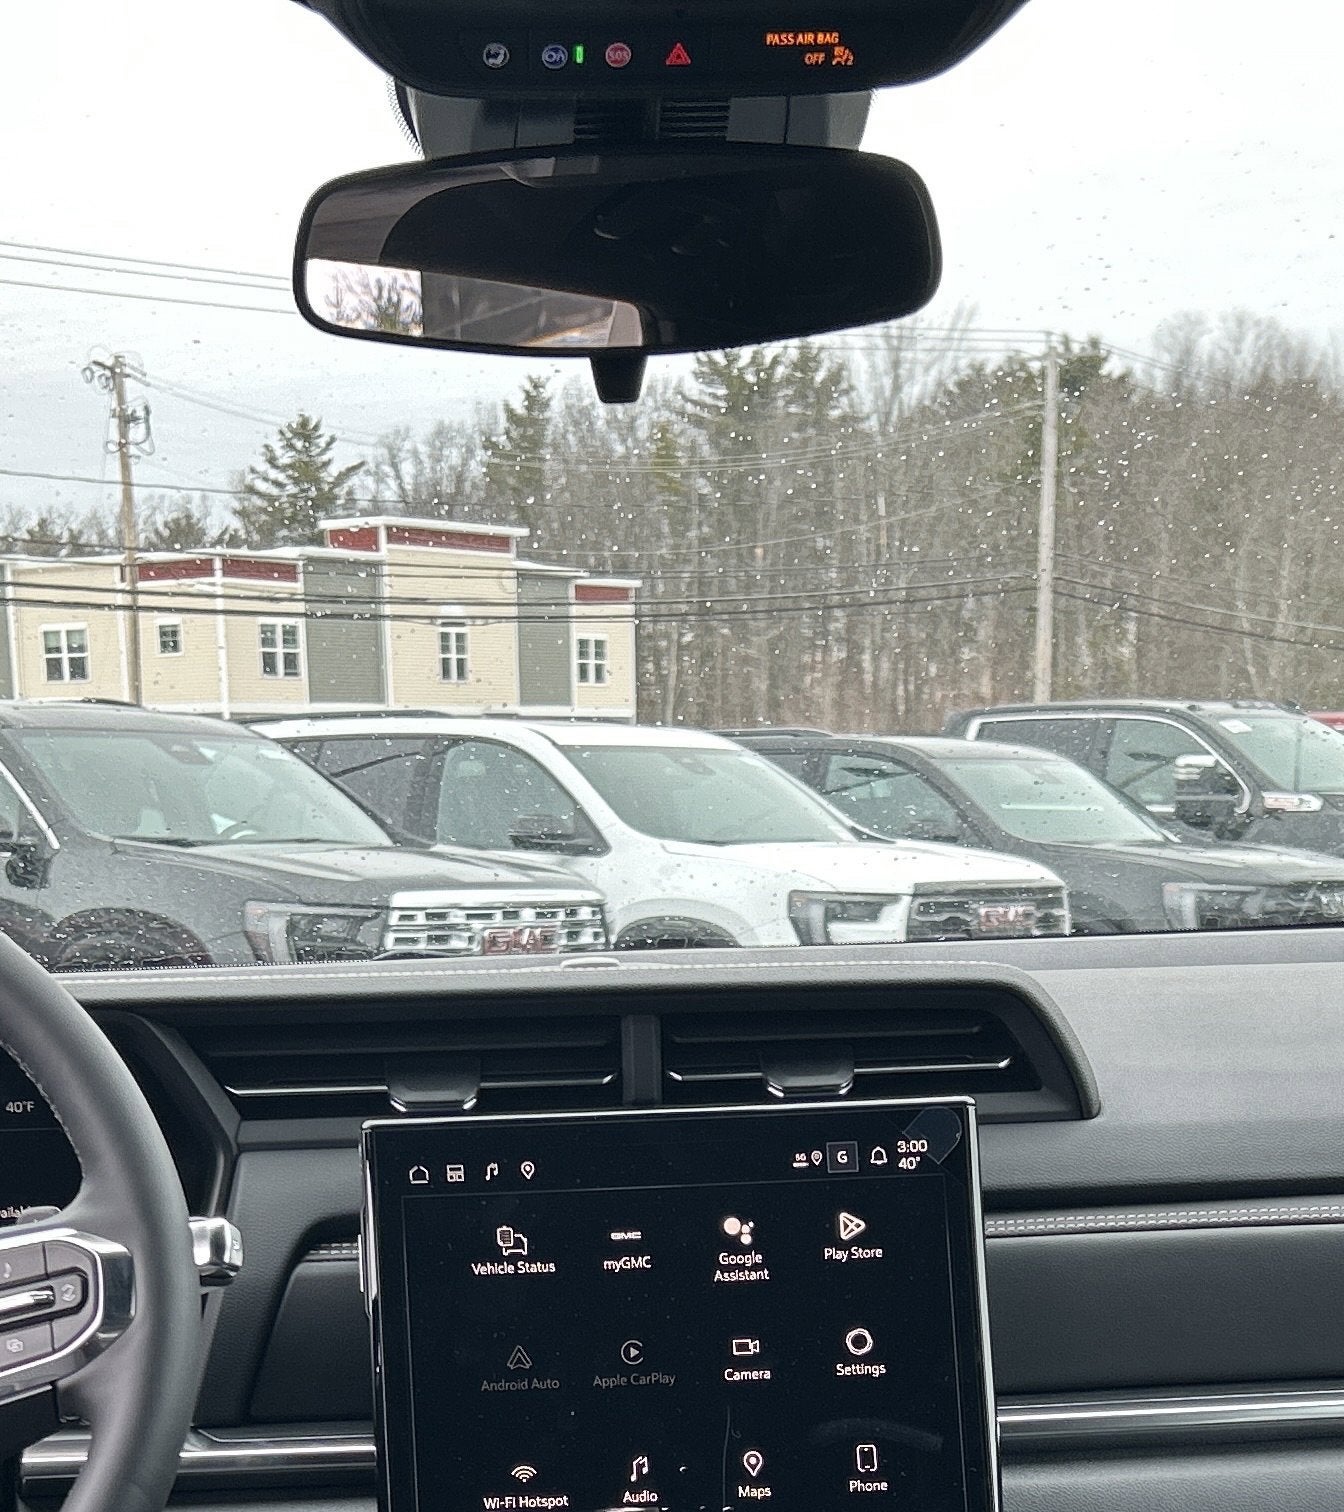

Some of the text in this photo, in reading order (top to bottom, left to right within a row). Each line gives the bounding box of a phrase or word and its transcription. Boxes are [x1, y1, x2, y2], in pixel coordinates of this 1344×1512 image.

[766, 31, 839, 45] PASS AIR BAG
[804, 52, 825, 65] OFF
[6, 1101, 35, 1113] 40°F
[896, 1140, 928, 1153] 3:00
[897, 1156, 921, 1170] 40°
[610, 1231, 642, 1240] GMC
[718, 1250, 763, 1267] Google
[824, 1246, 883, 1262] Play Store
[471, 1260, 556, 1276] Vehicle Status
[603, 1255, 652, 1272] myGMC
[714, 1267, 770, 1283] Assistant
[724, 1368, 771, 1381] Camera
[836, 1363, 887, 1378] Settings
[481, 1378, 560, 1391] Android Auto
[593, 1372, 676, 1389] Apple CarPlay
[738, 1485, 772, 1500] Maps
[849, 1480, 888, 1492] Phone
[483, 1495, 569, 1510] Wi-Fi Hotspot
[622, 1490, 658, 1503] Audio
